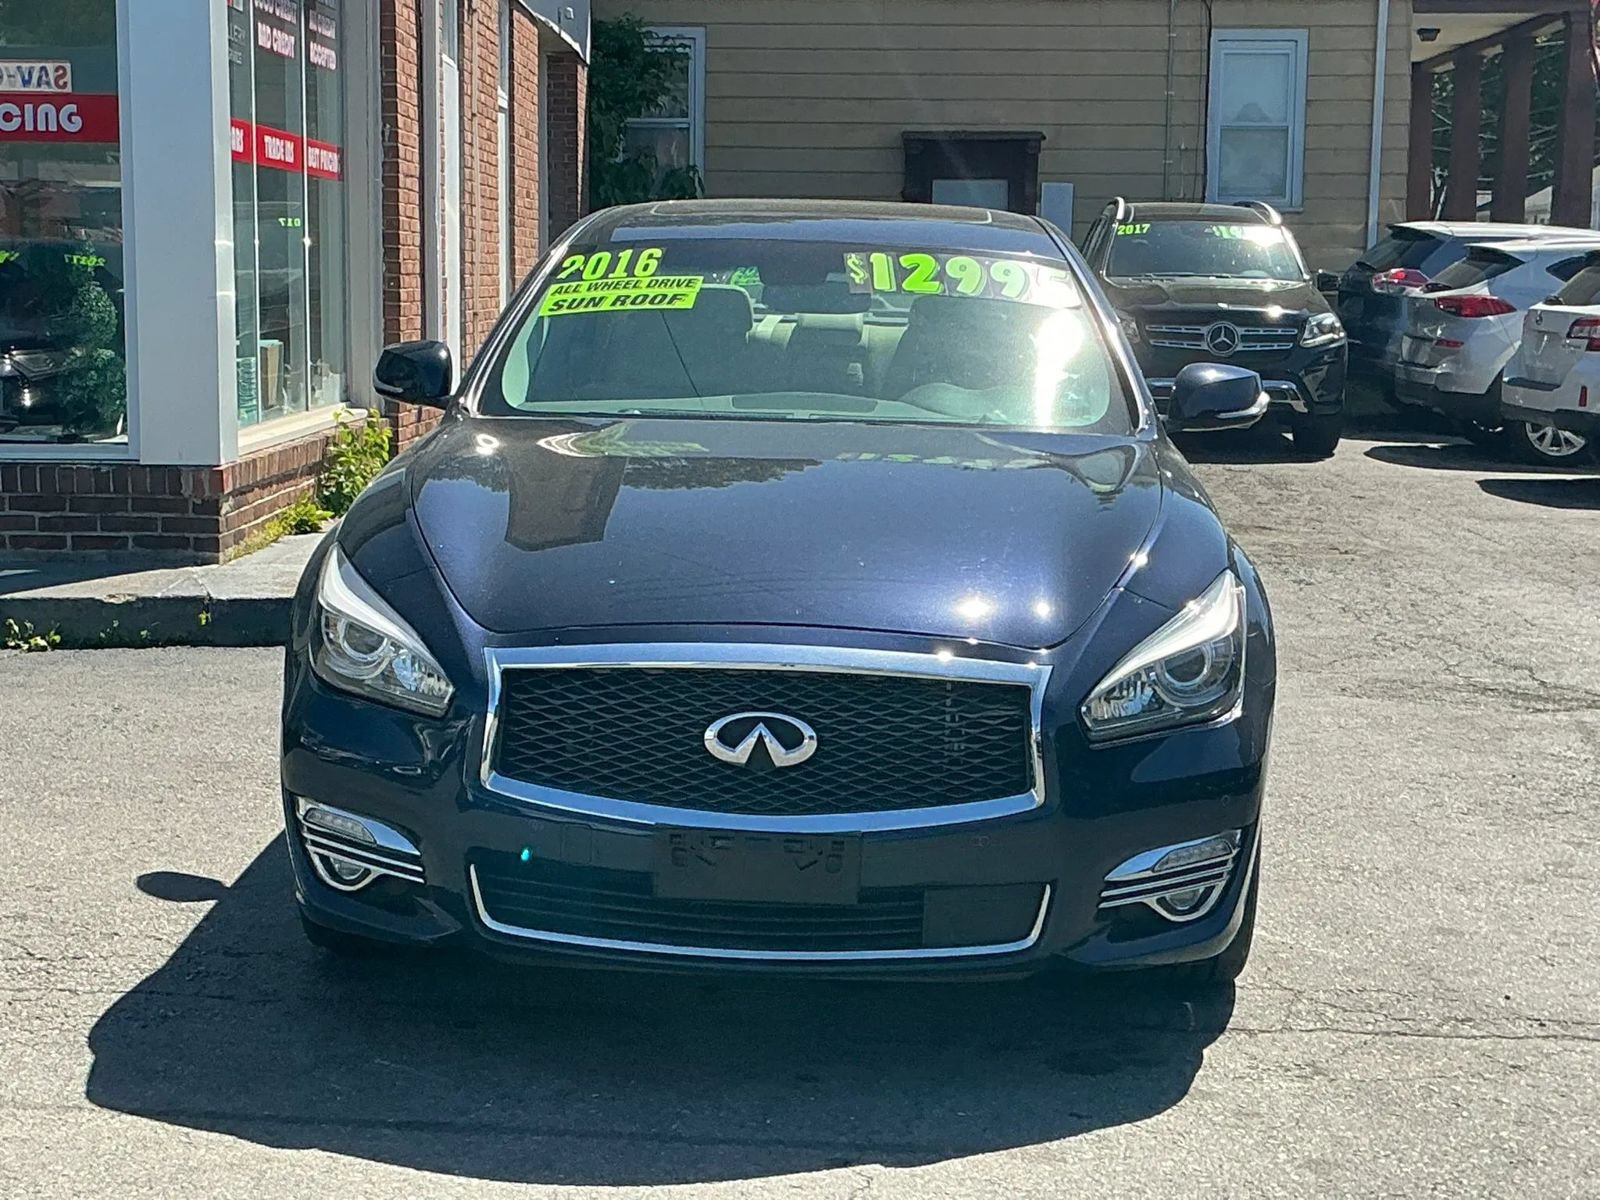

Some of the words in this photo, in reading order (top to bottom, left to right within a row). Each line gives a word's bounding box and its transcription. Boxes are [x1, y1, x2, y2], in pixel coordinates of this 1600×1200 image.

[1116, 223, 1151, 236] 2017
[556, 248, 664, 281] 2016
[551, 283, 583, 297] ALL
[586, 278, 644, 294] WHEEL
[645, 277, 700, 290] DRIVE
[547, 296, 604, 312] SUN
[609, 292, 688, 308] ROOF
